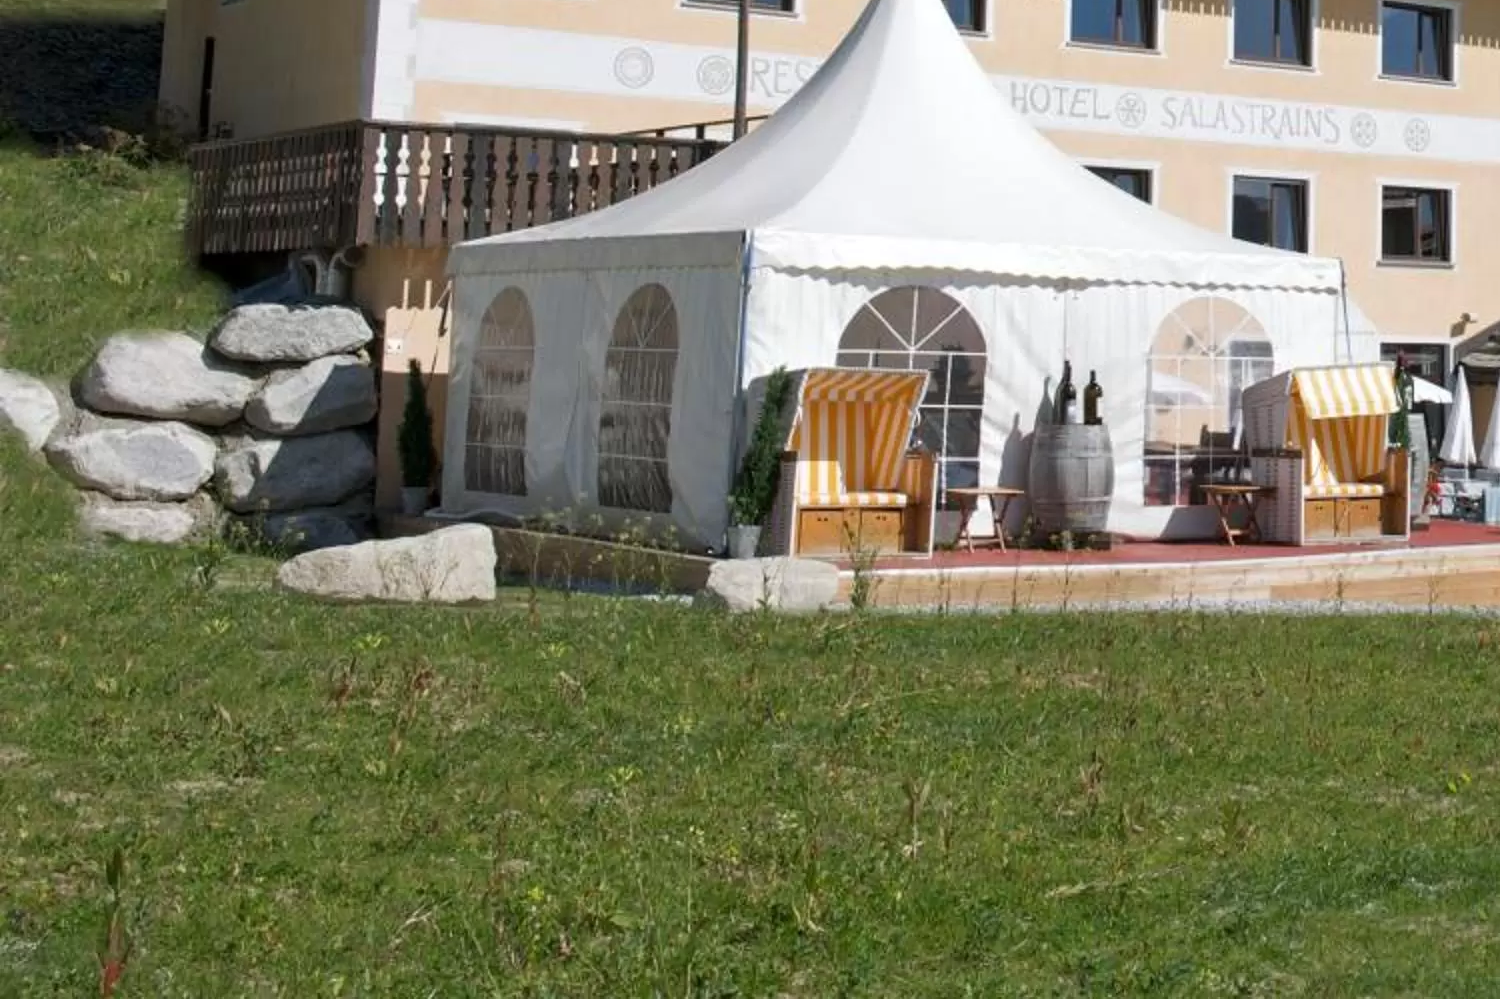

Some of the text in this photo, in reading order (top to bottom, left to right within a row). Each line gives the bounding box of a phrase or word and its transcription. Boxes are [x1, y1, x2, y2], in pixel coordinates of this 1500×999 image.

[750, 57, 1340, 143] RES HOTEL SALASTRAINS
